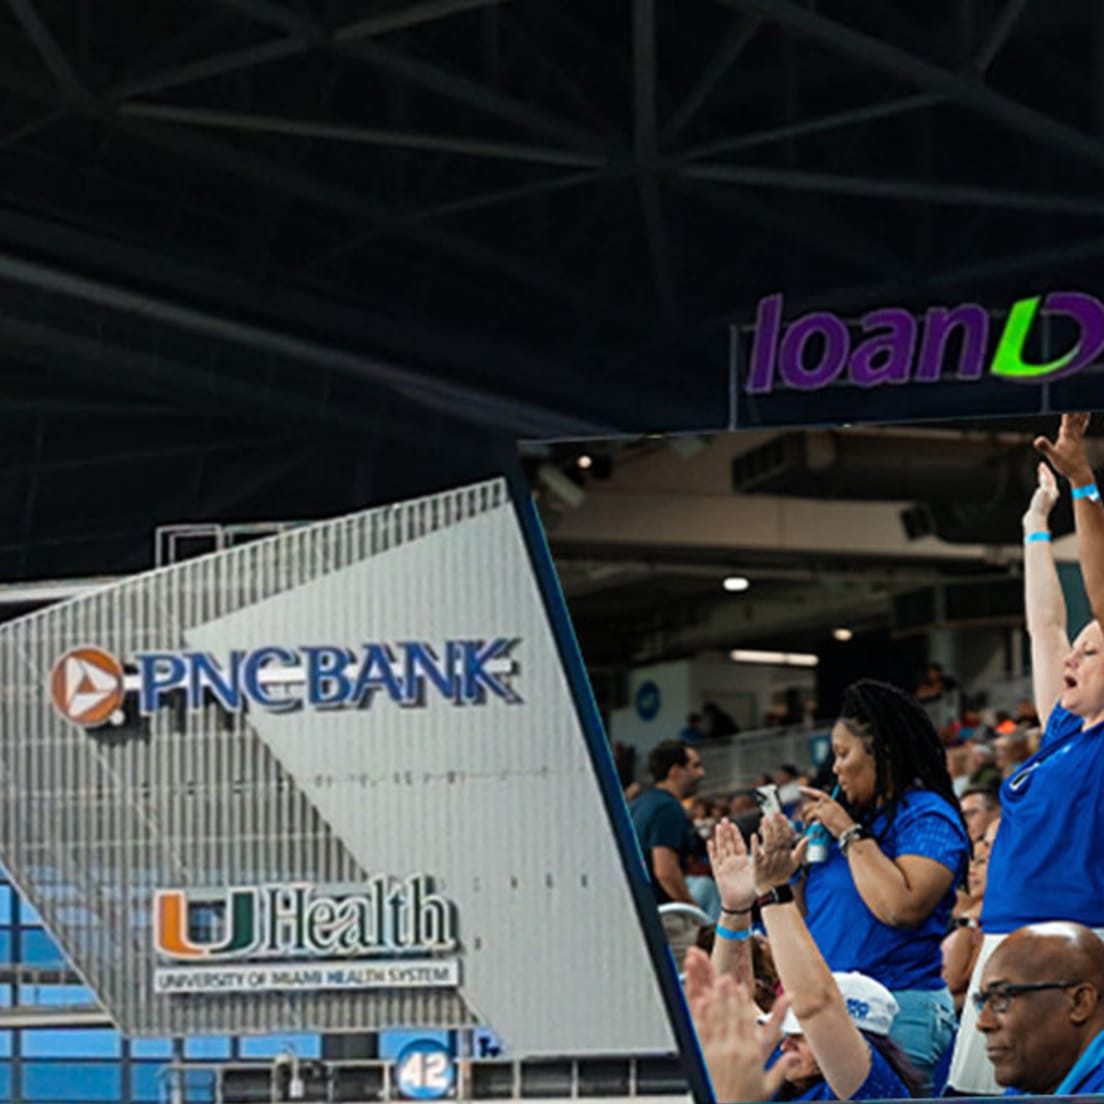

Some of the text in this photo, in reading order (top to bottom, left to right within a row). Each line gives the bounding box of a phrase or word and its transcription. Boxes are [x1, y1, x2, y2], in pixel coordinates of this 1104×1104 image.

[158, 966, 449, 990] UNIVERSITY OF MIAMI HEALTH SYSTEM
[402, 1051, 449, 1087] 42
